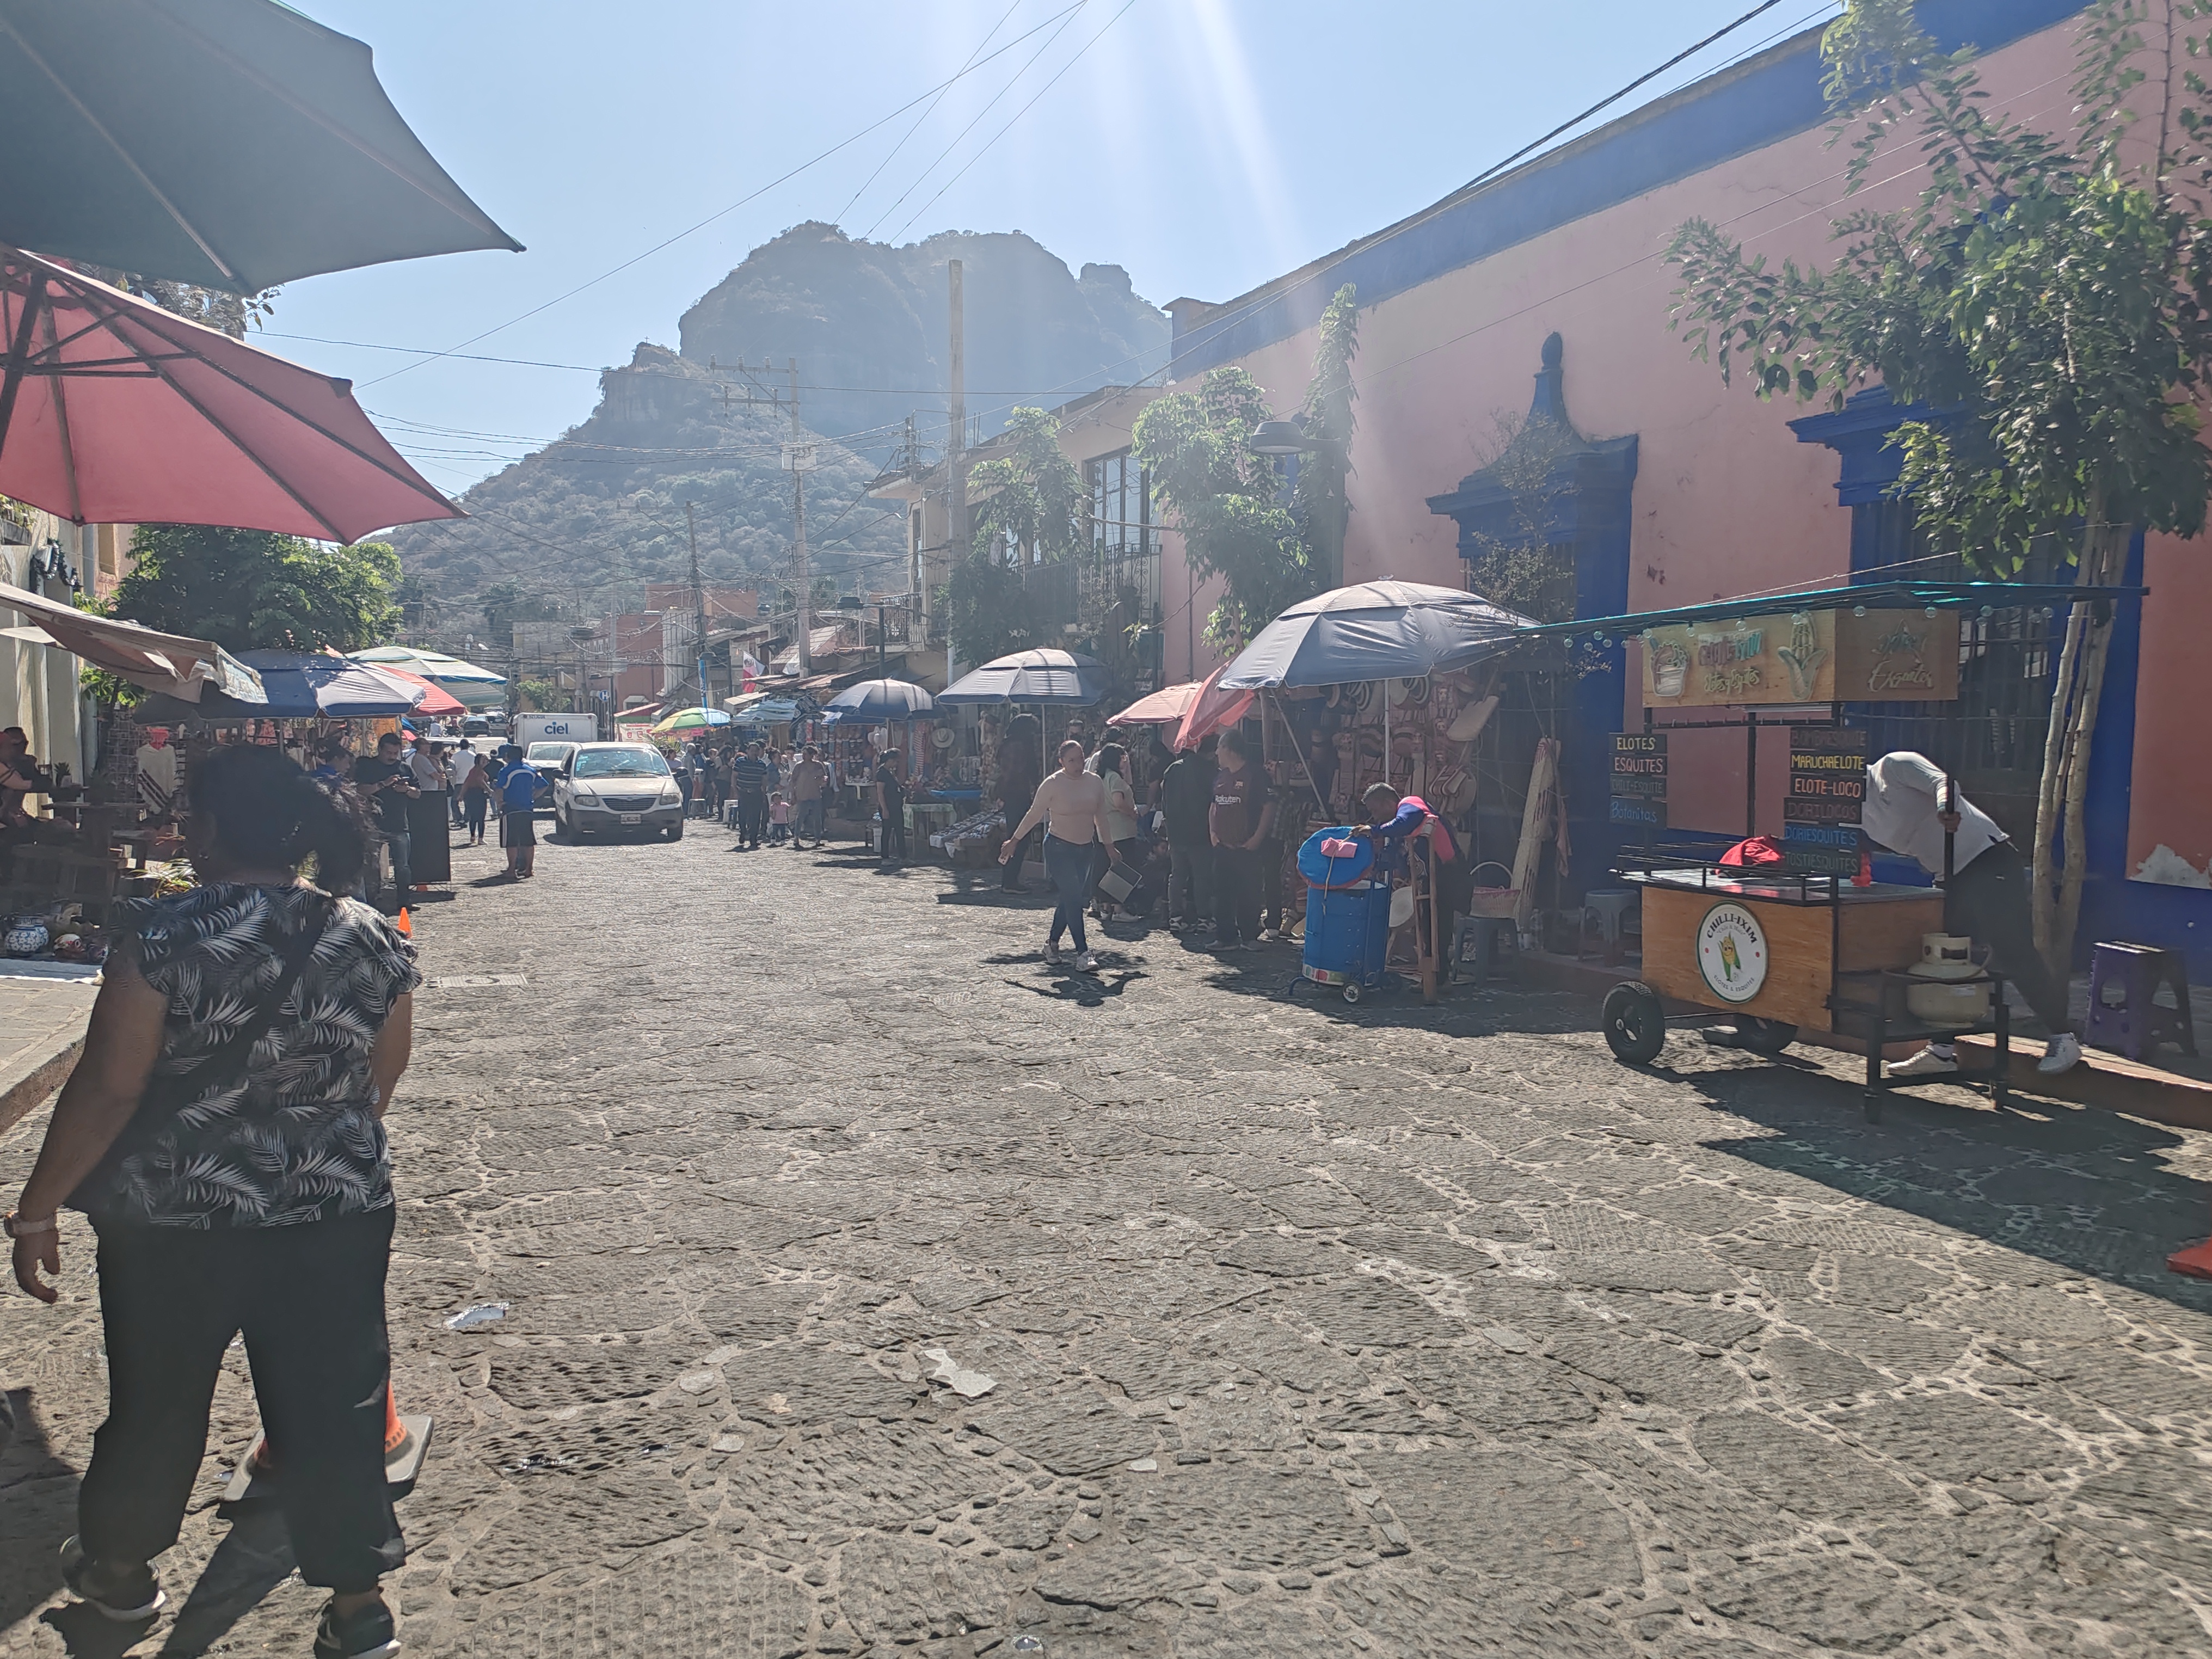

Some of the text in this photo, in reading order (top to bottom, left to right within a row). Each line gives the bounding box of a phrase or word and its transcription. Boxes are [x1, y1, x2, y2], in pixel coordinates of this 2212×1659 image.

[544, 721, 569, 735] ciel
[1616, 737, 1656, 750] ELOTES
[1614, 757, 1663, 773] ESQUITES
[1791, 754, 1866, 770] MARUCHAELOTE
[1795, 778, 1861, 798] ELOTE-LOCO
[1215, 795, 1241, 803] Rakuten
[1611, 801, 1657, 823] Botanitas
[1787, 802, 1857, 820] DORILOCOS
[1785, 826, 1858, 846] DORIESQUITES
[1785, 851, 1858, 872] TOSTIESQUITES
[1707, 913, 1758, 944] CHILLI-IXIM
